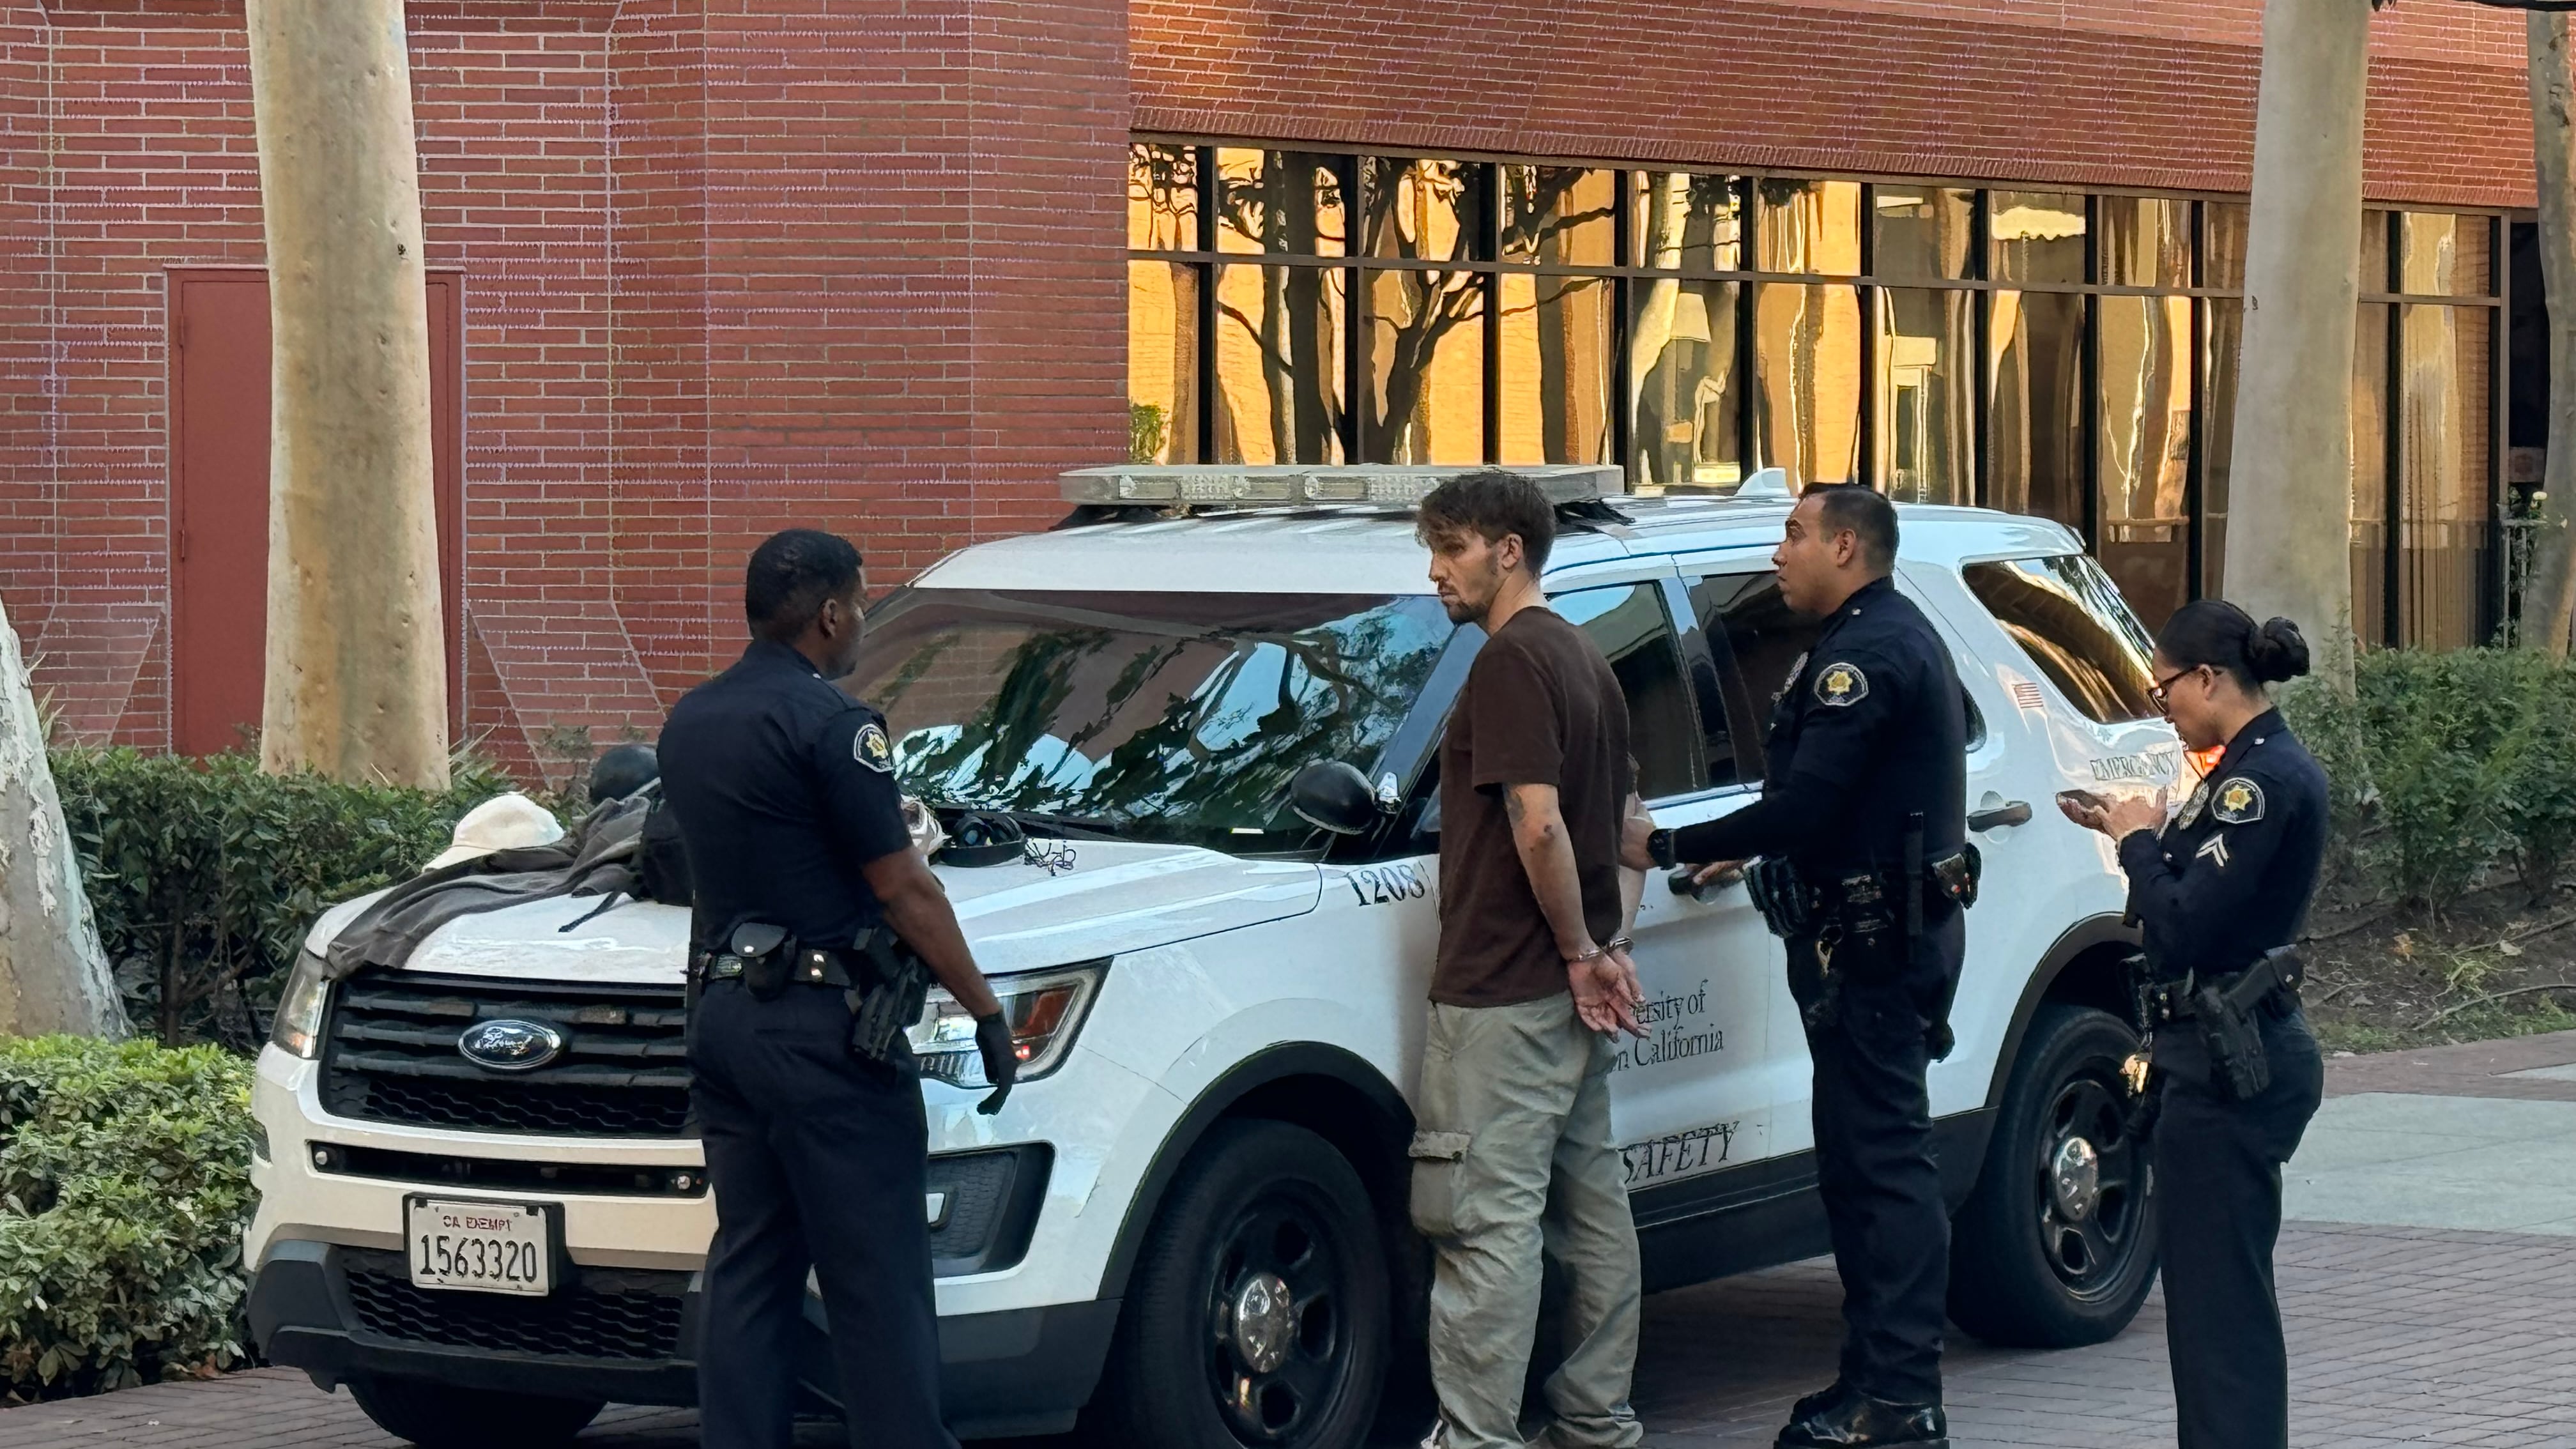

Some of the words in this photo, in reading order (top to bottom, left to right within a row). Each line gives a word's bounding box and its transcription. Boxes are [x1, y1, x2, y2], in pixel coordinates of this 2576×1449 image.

[1347, 864, 1425, 906] 1208
[1636, 991, 1684, 1030] ersity
[1688, 979, 1708, 1015] of
[1635, 1023, 1723, 1066] California
[1623, 1121, 1740, 1184] SAFETY
[443, 1216, 460, 1227] CA
[420, 1235, 537, 1283] 1563320
